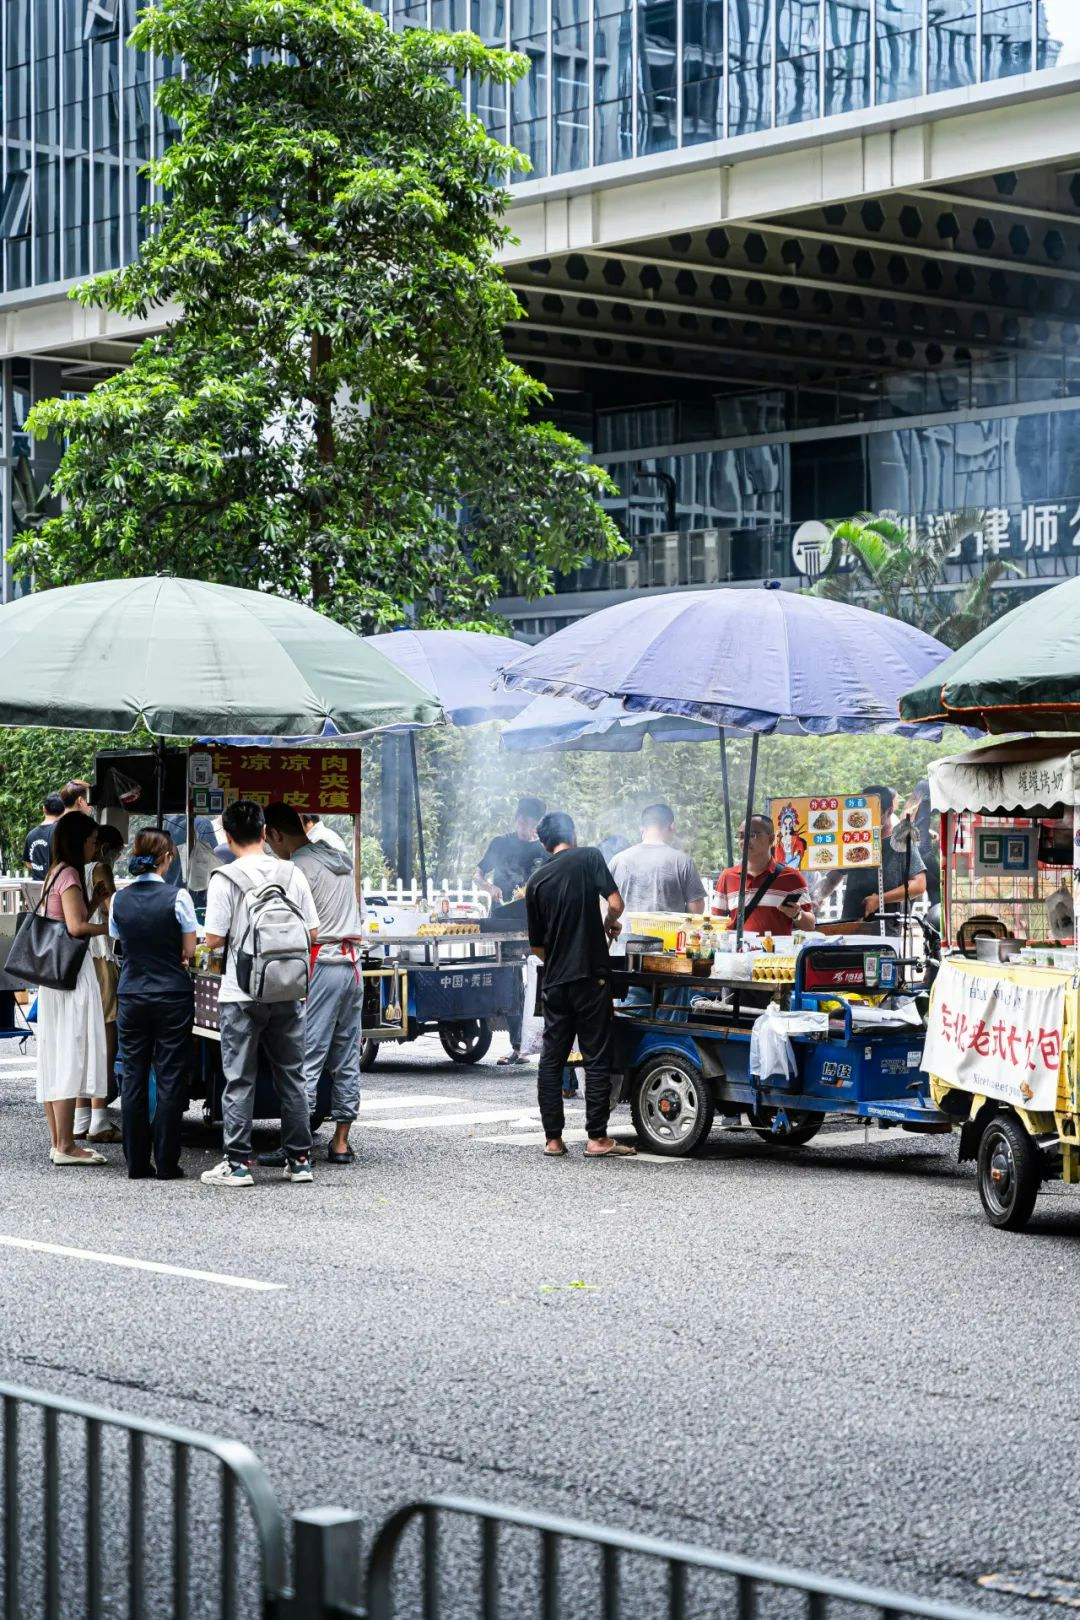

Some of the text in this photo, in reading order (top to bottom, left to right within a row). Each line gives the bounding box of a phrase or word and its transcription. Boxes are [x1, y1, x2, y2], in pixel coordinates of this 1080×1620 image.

[280, 754, 311, 808] 凉皮
[318, 755, 350, 808] 肉夹馍
[1018, 769, 1064, 796] 罐罐烤奶
